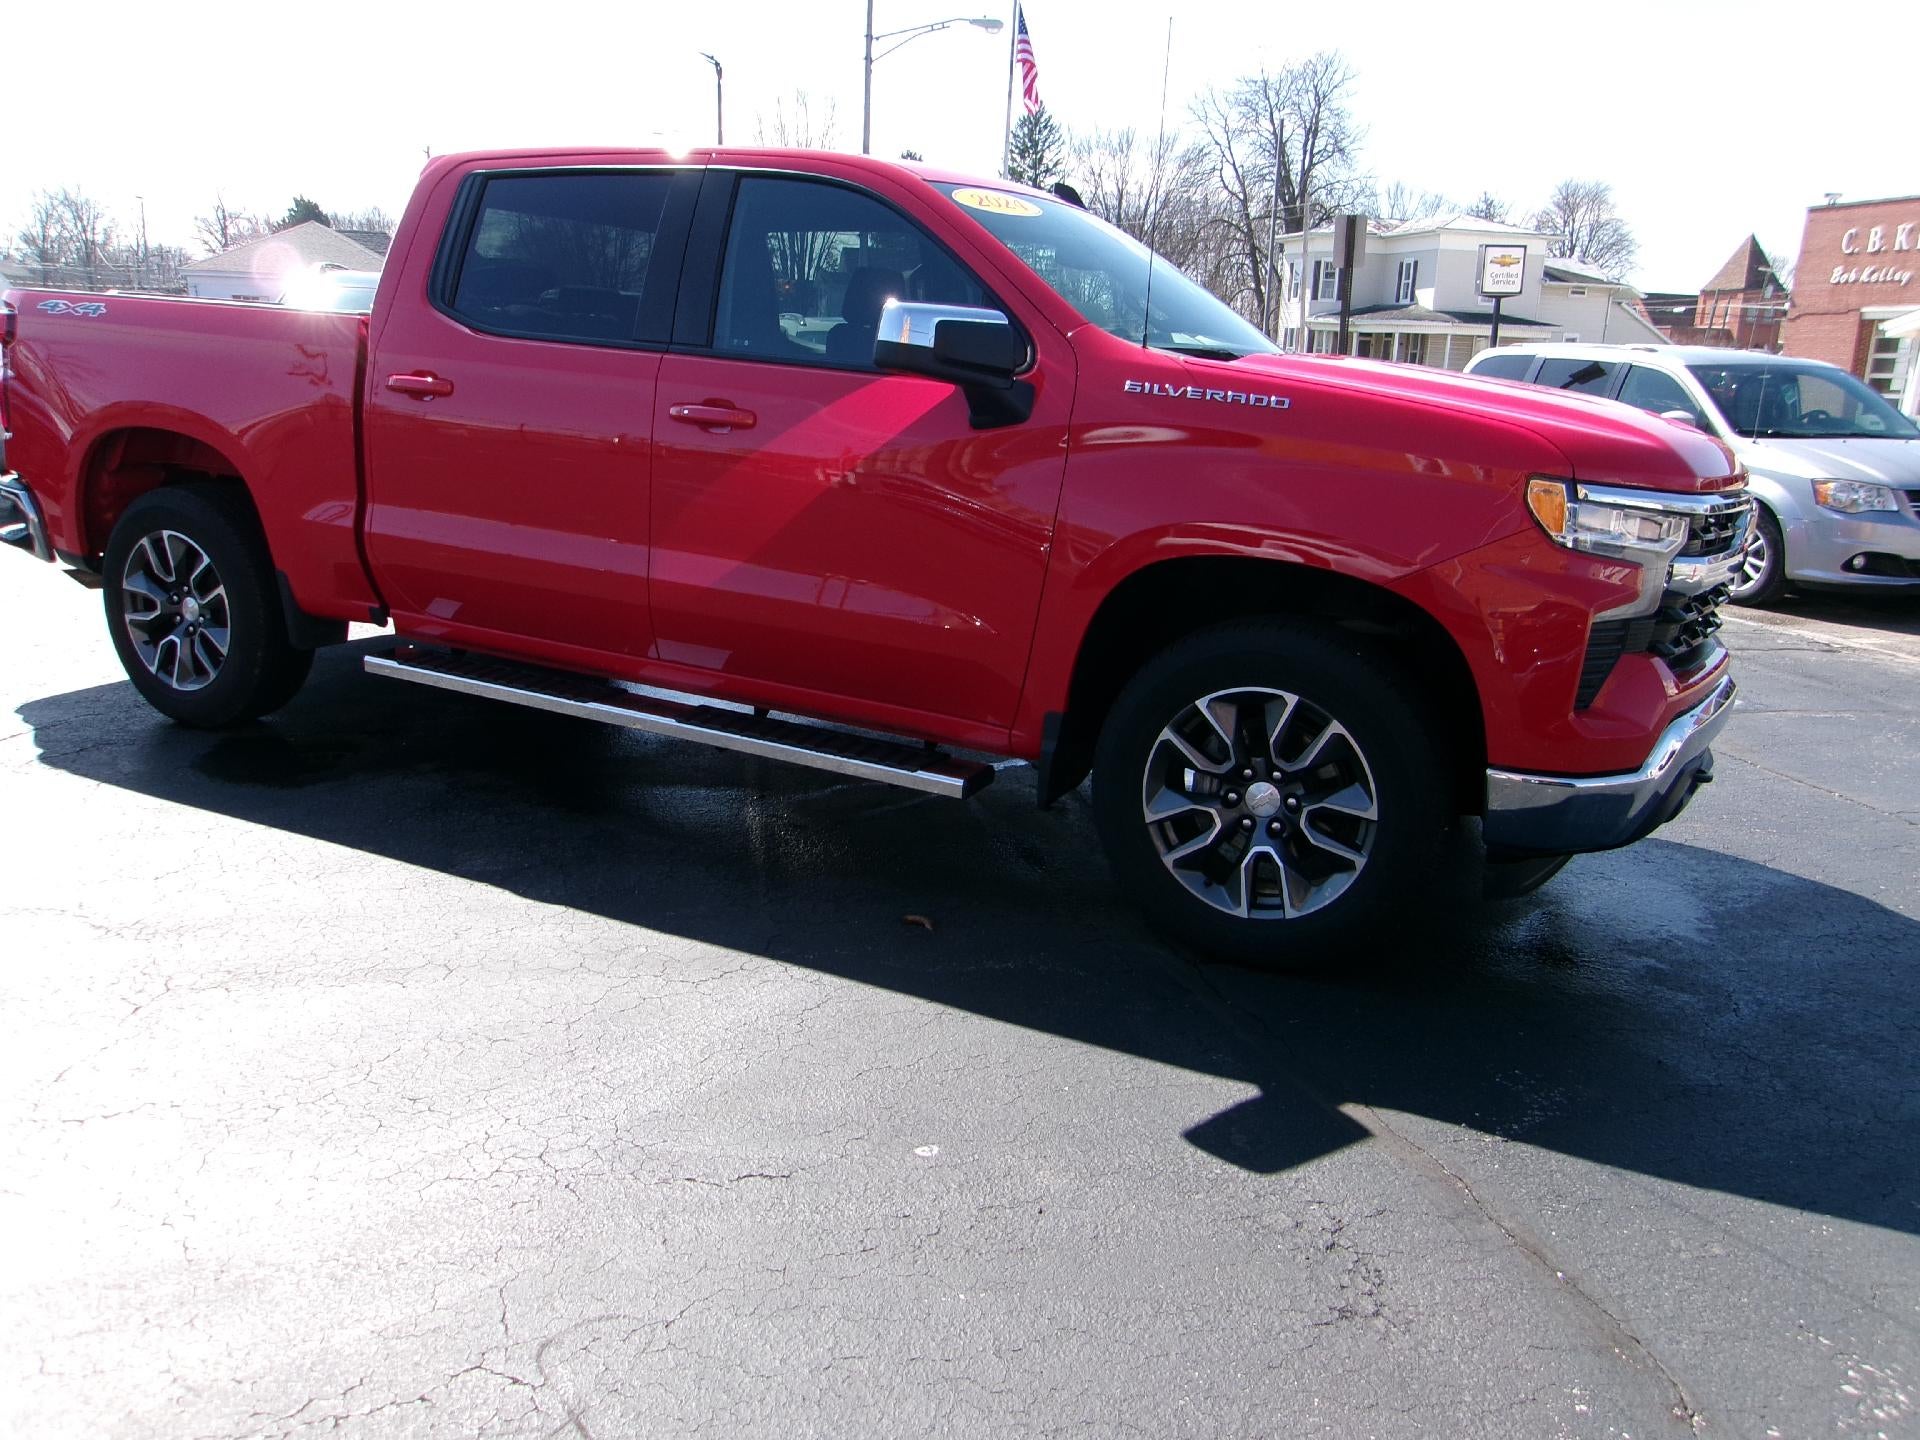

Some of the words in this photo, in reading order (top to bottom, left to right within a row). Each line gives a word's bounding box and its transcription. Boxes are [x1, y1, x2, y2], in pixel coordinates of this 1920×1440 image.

[1893, 221, 1920, 251] K
[1830, 264, 1859, 284] Bob
[1859, 264, 1913, 287] Kelley
[1124, 379, 1291, 409] SILVERADO
